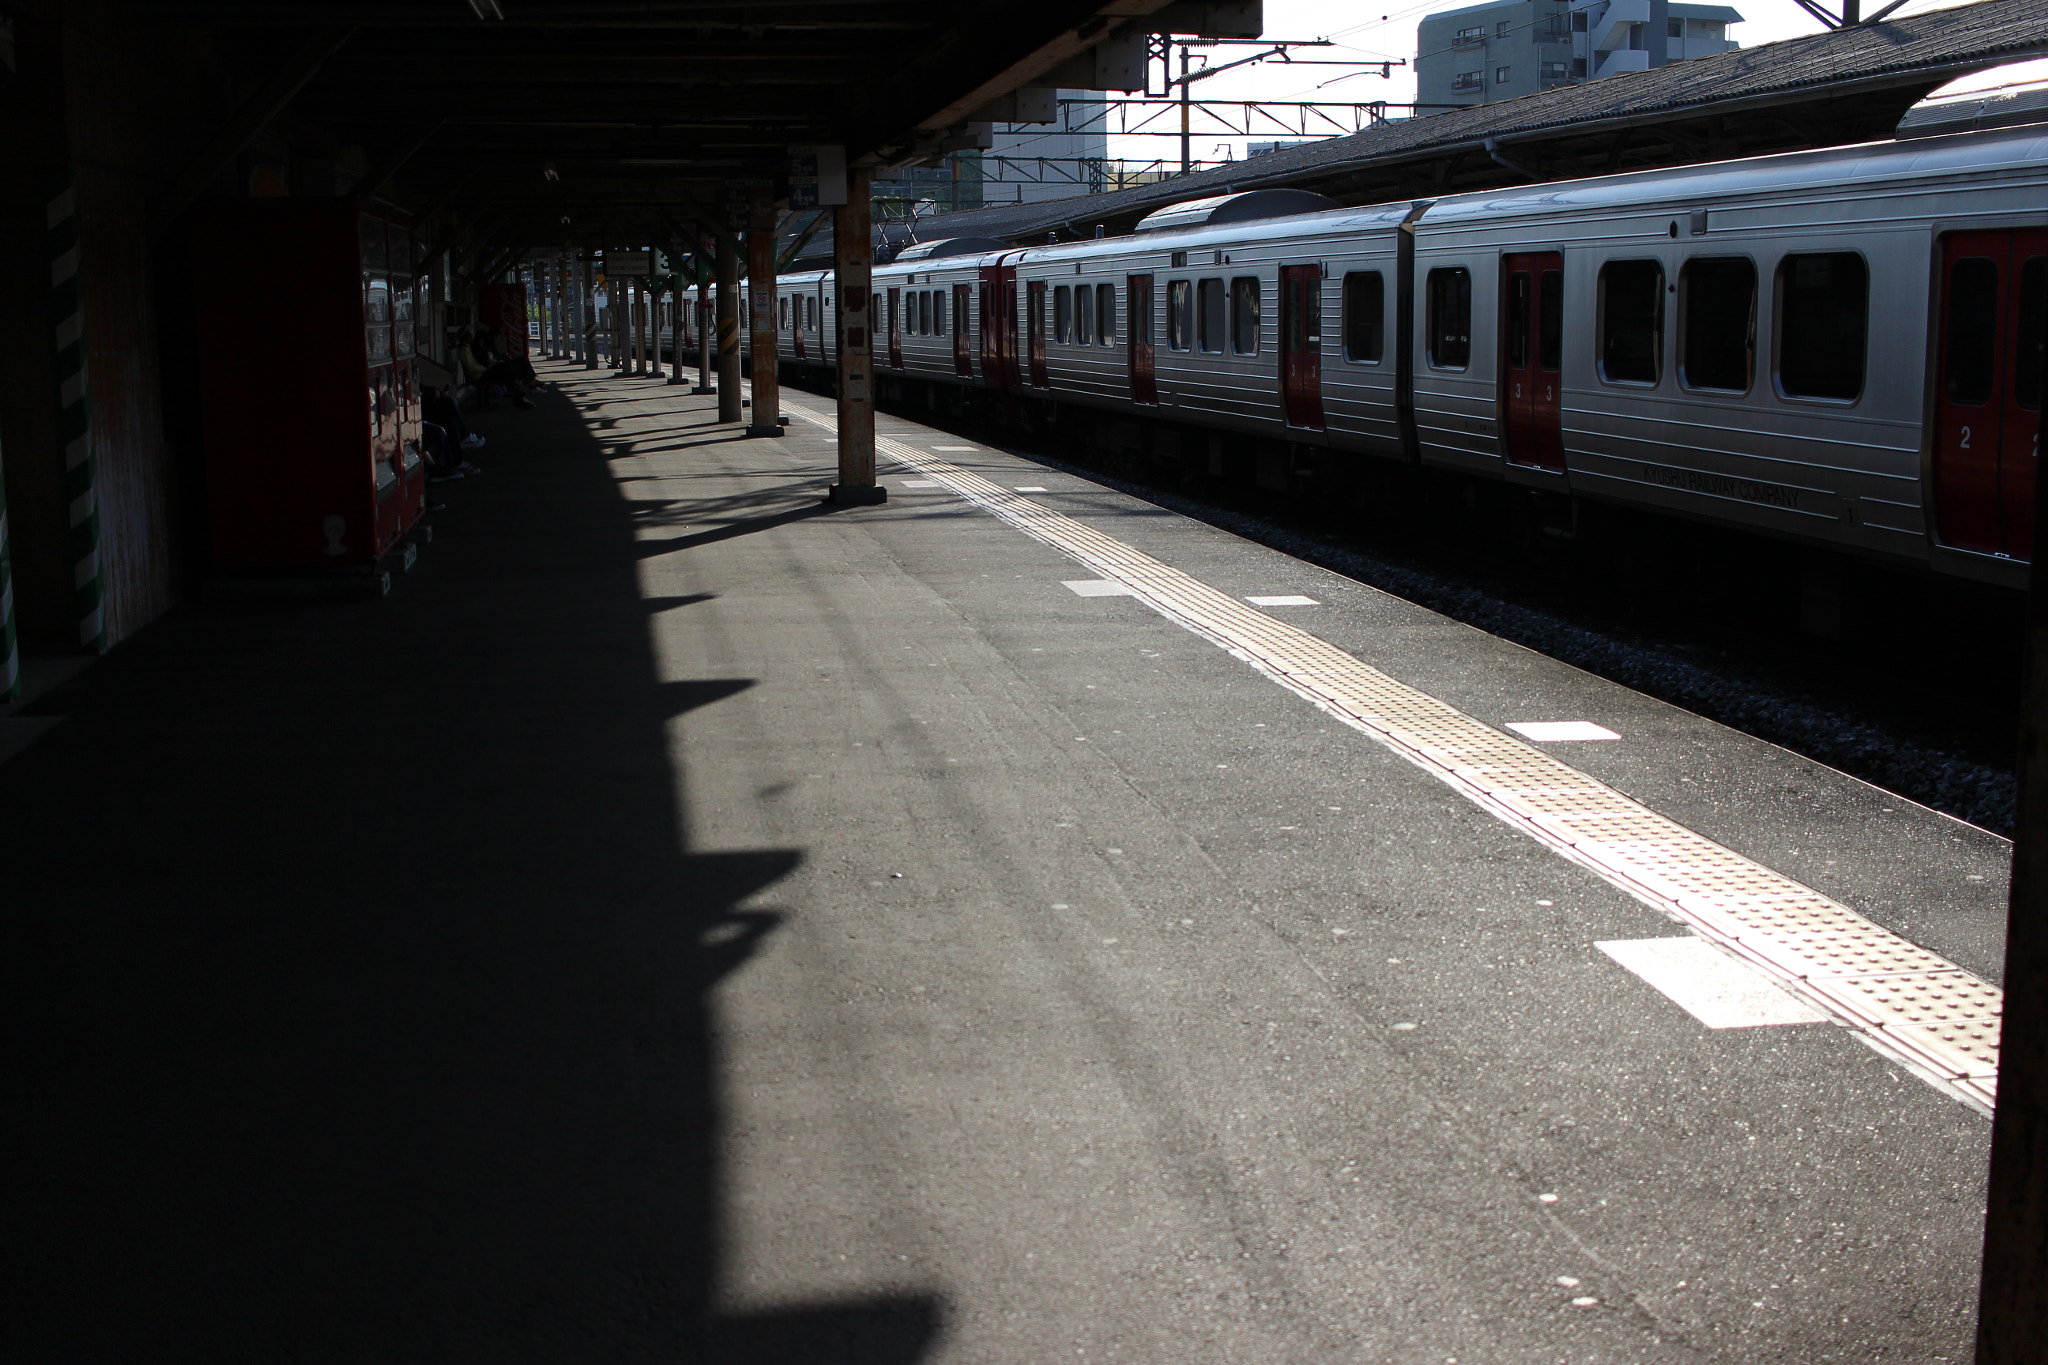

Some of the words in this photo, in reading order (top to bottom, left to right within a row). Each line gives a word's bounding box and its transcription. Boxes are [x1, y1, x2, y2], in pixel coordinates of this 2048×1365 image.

[1515, 382, 1521, 398] 3
[1546, 385, 1552, 401] 3
[1960, 425, 1971, 448] 2
[1643, 464, 1686, 488] KYUSHU
[1689, 473, 1736, 496] RAILWAY
[1739, 481, 1799, 507] COMPANY
